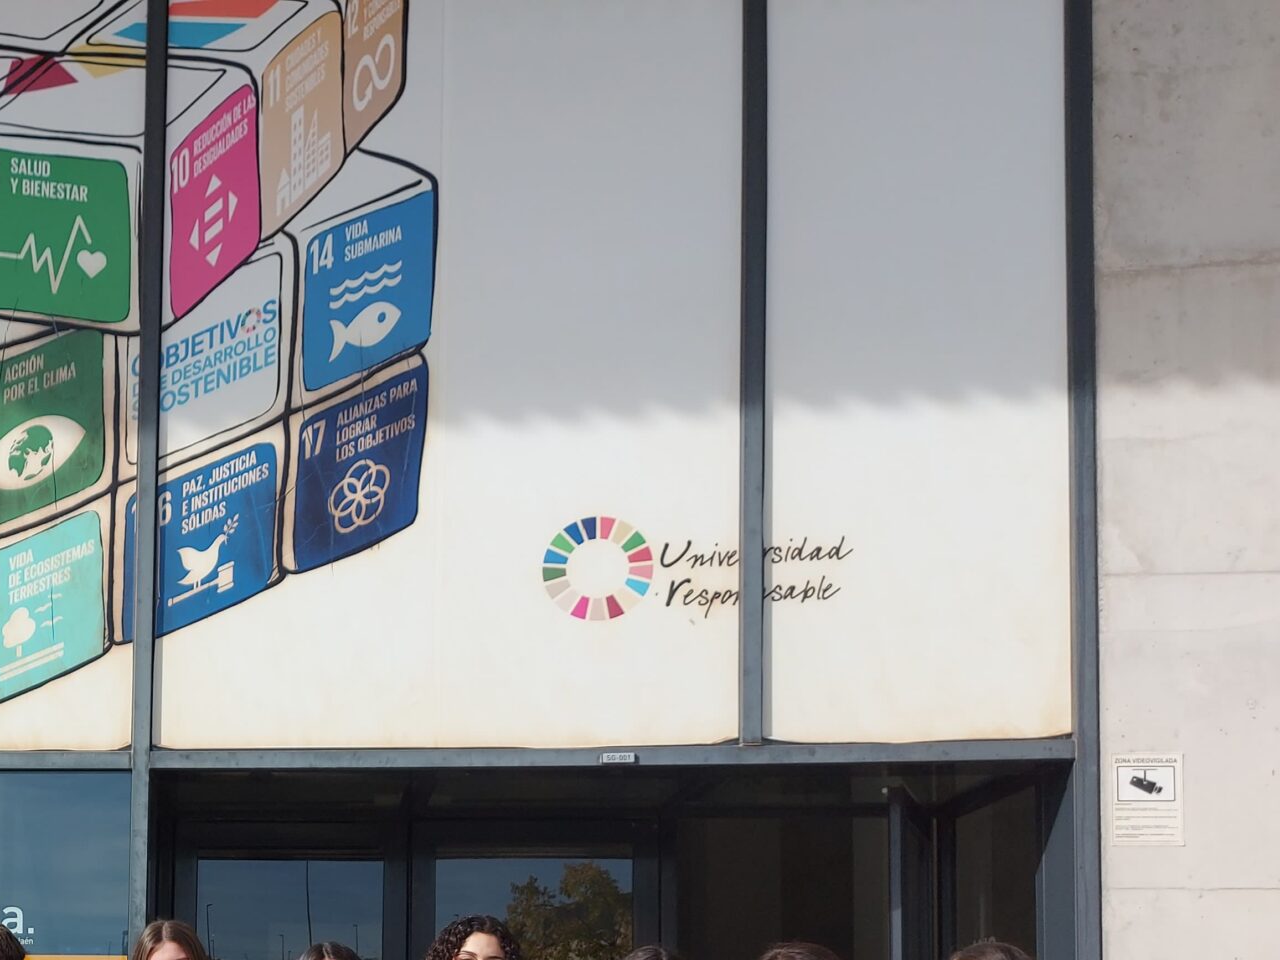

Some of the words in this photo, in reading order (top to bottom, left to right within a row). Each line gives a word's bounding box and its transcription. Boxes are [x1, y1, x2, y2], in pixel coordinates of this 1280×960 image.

[269, 64, 280, 107] 11
[194, 111, 232, 157] REDUCCIÓN
[233, 102, 242, 123] DE
[243, 93, 256, 114] LAS
[10, 157, 51, 177] SALUD
[194, 118, 248, 178] DESIGUALDADES
[10, 178, 19, 195] Y
[22, 179, 89, 202] BIENESTAR
[172, 148, 189, 194] 10
[344, 219, 369, 243] VIDA
[344, 226, 402, 263] SUBMARINA
[310, 233, 335, 275] 14
[4, 353, 45, 384] ACCIÓN
[171, 327, 277, 385] DESARROLLO
[3, 382, 25, 405] POR
[28, 377, 40, 395] EL
[43, 362, 76, 389] CLIMA
[337, 391, 387, 428] ALIANZAS
[389, 378, 418, 403] PARA
[302, 419, 326, 460] 17
[336, 414, 377, 446] LOGRAR
[336, 442, 355, 463] LOS
[357, 414, 416, 453] OBJETIVOS
[182, 475, 206, 498] PAZ,
[209, 450, 257, 485] JUSTICIA
[182, 500, 189, 516] E
[191, 463, 269, 513] INSTITUCIONES
[181, 501, 226, 535] SÓLIDAS
[8, 570, 22, 588] DE
[24, 539, 95, 582] ECOSISTEMAS
[9, 549, 34, 571] VIDA
[660, 536, 854, 569] Universidad
[8, 567, 71, 605] TERRESTRES
